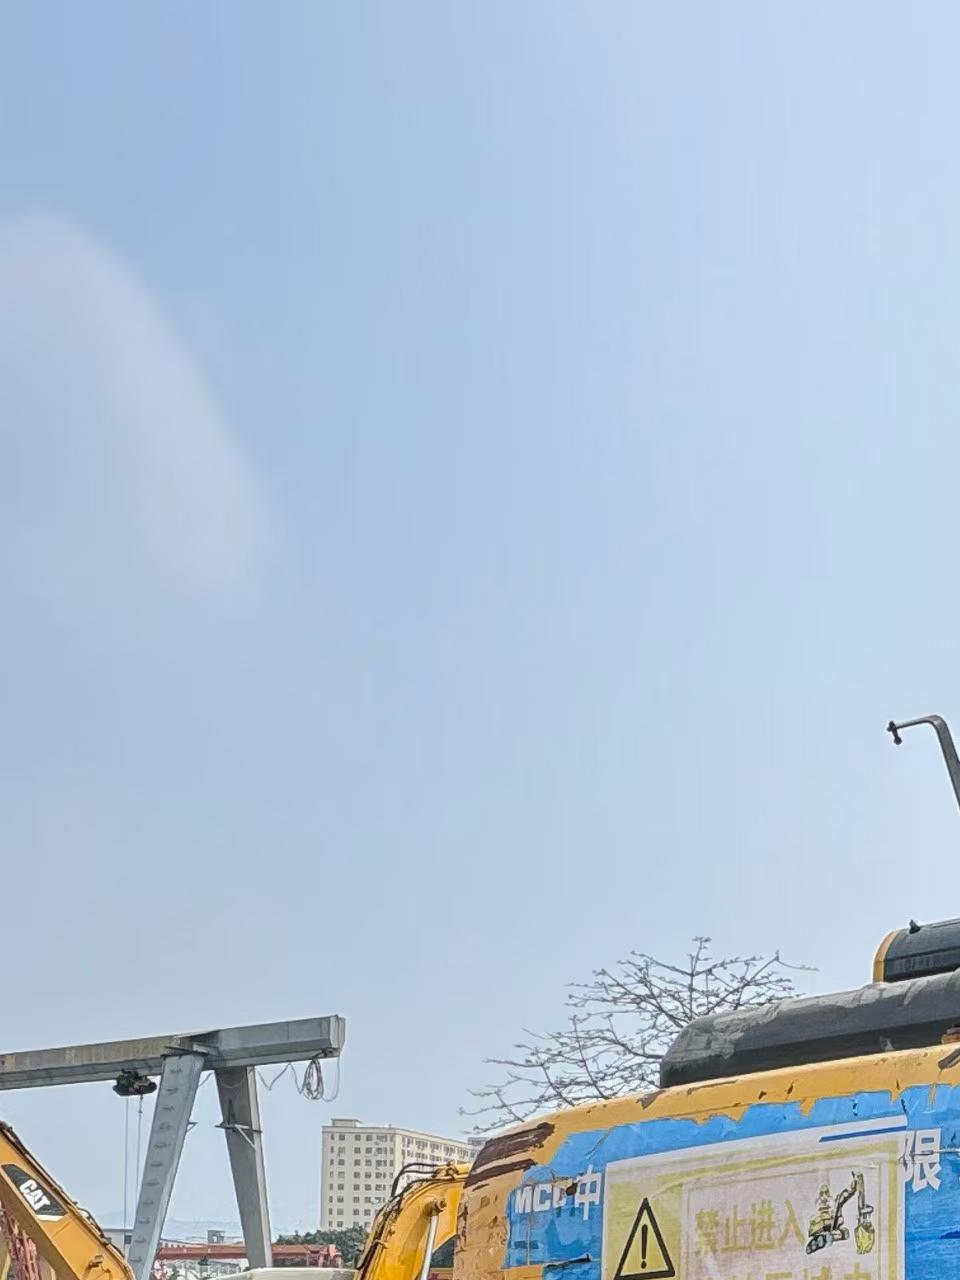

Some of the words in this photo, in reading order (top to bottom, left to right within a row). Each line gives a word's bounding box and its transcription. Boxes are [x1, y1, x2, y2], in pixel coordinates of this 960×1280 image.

[20, 1179, 51, 1211] CAT
[696, 1199, 805, 1257] 禁止进入
